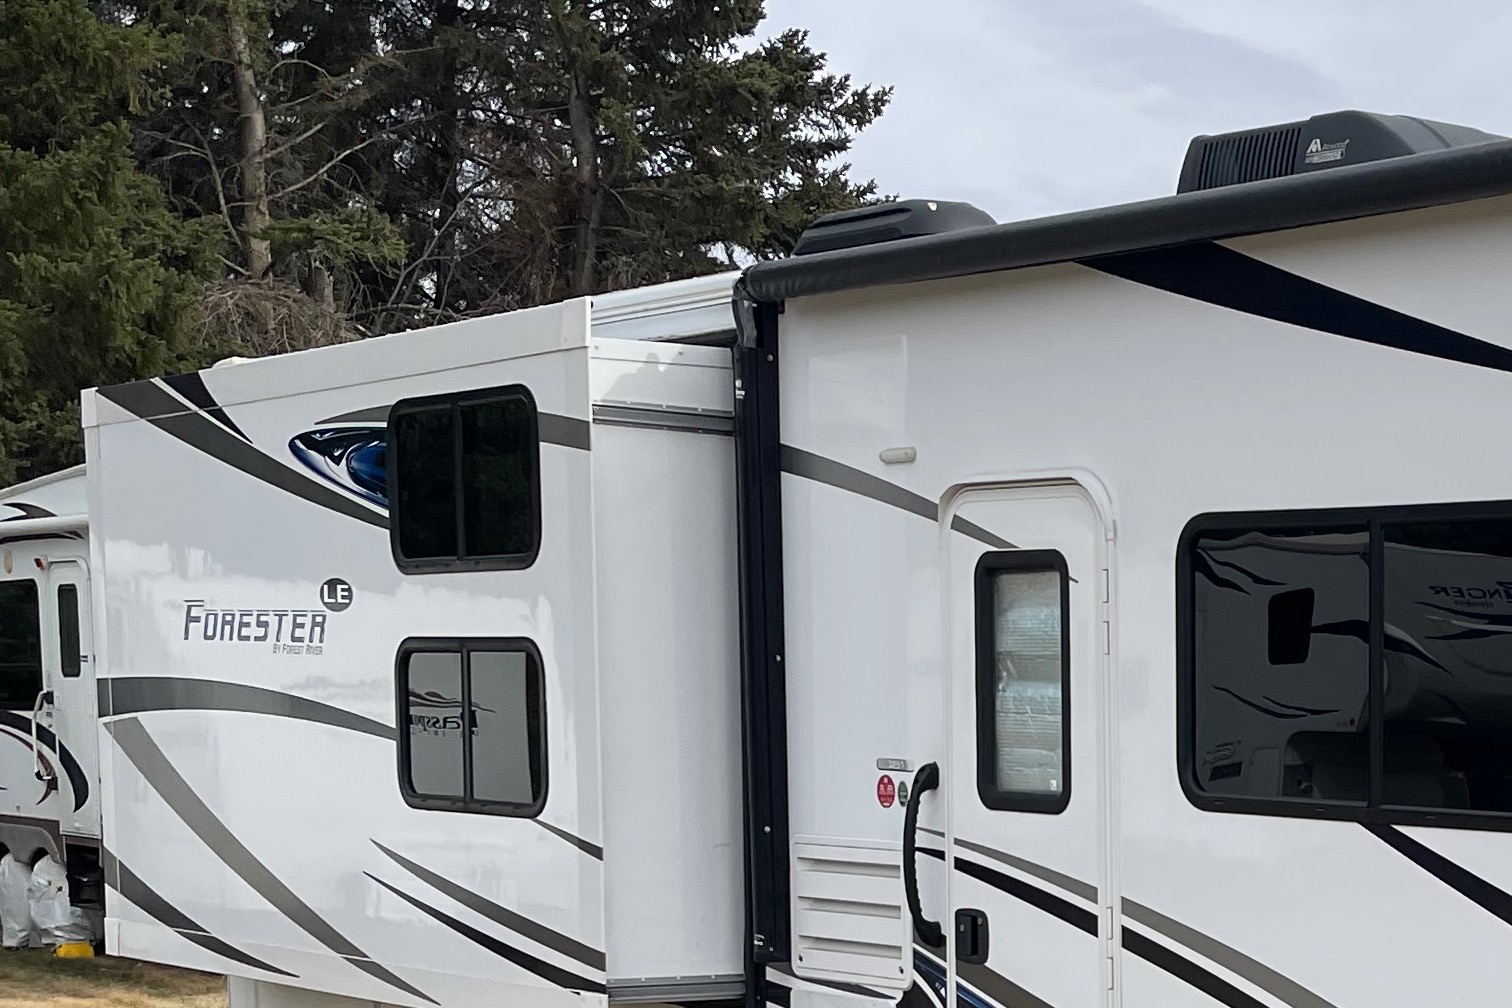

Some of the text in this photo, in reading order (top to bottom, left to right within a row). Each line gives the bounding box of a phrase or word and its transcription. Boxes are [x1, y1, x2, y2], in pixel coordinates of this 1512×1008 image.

[322, 583, 351, 604] LE
[183, 599, 327, 643] FORESTER
[282, 643, 304, 655] FOREST
